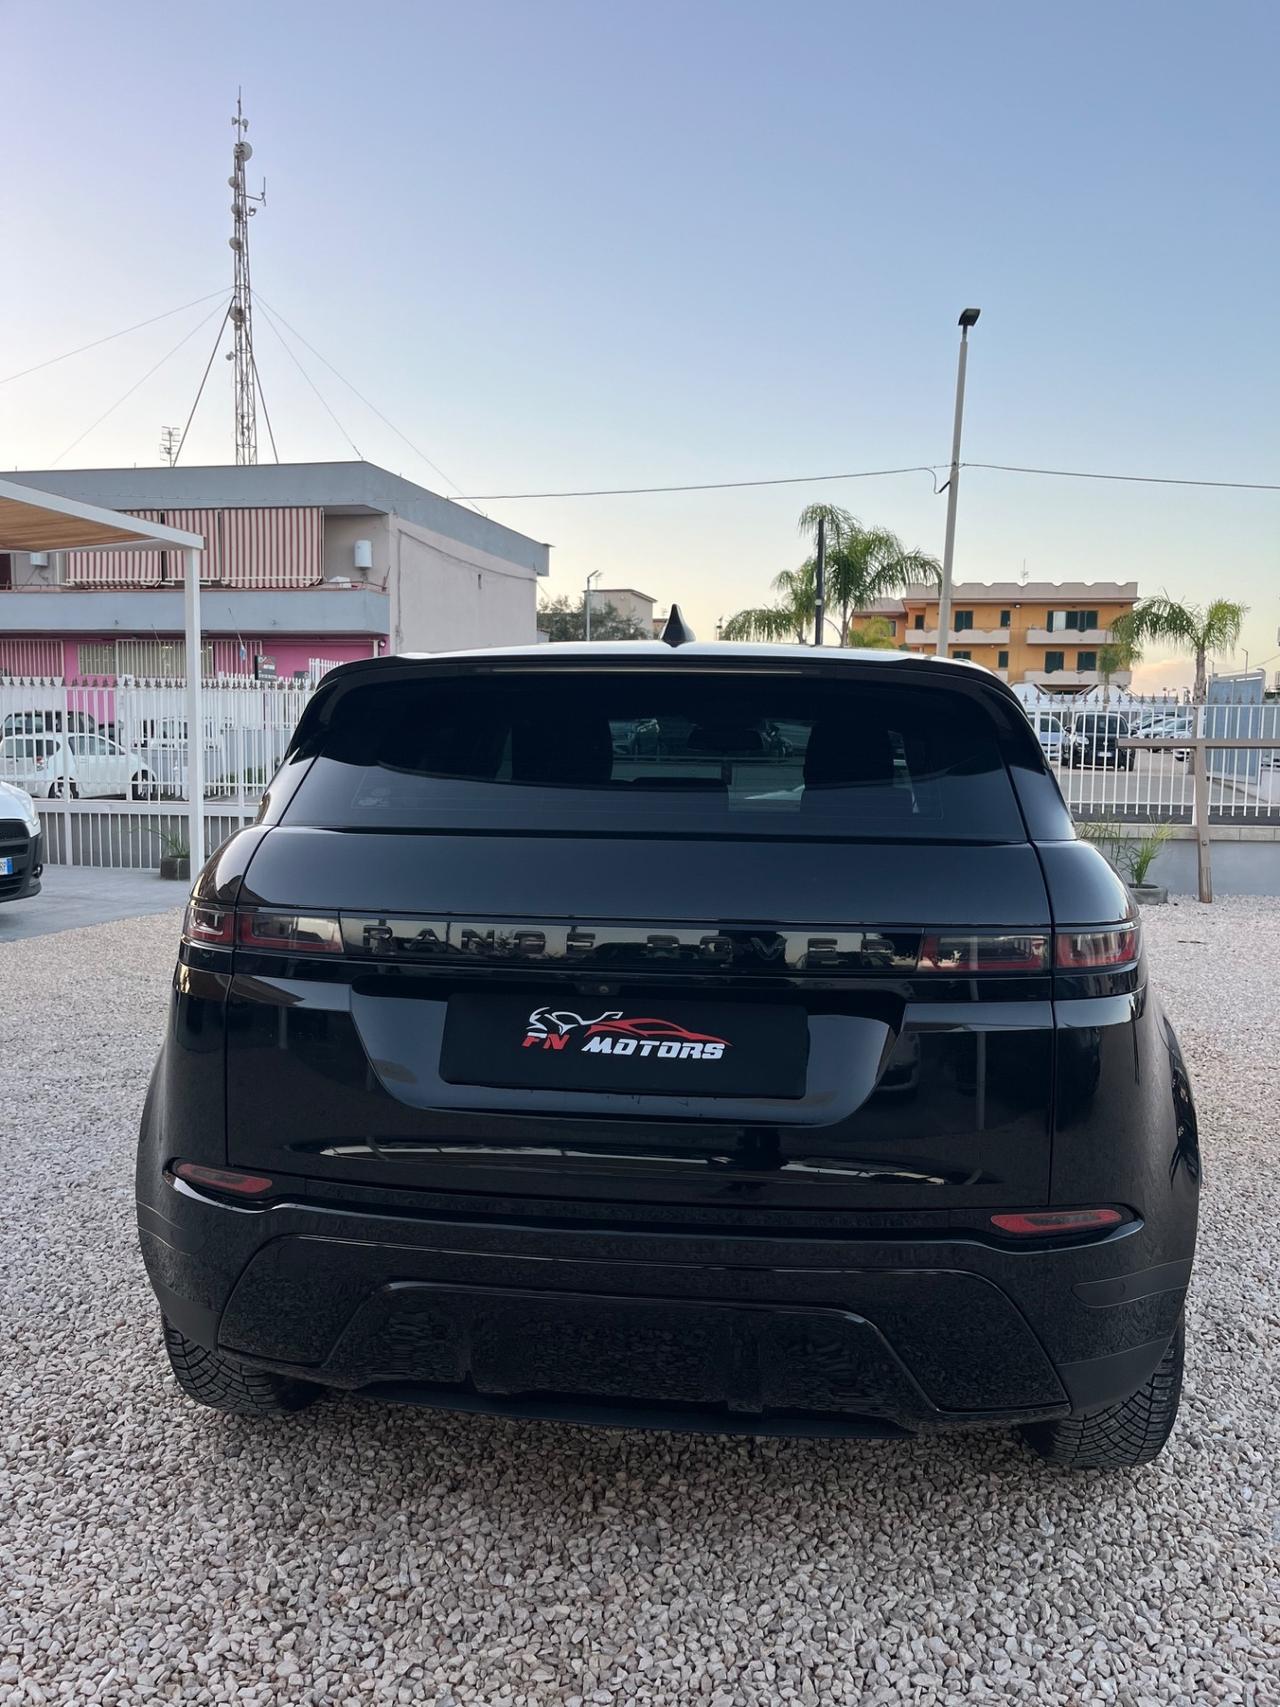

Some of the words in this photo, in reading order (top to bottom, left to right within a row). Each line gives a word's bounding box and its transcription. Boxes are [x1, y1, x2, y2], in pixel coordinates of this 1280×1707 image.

[363, 925, 596, 956] RANGE
[521, 1032, 570, 1050] FN
[581, 1036, 725, 1060] MOTORS
